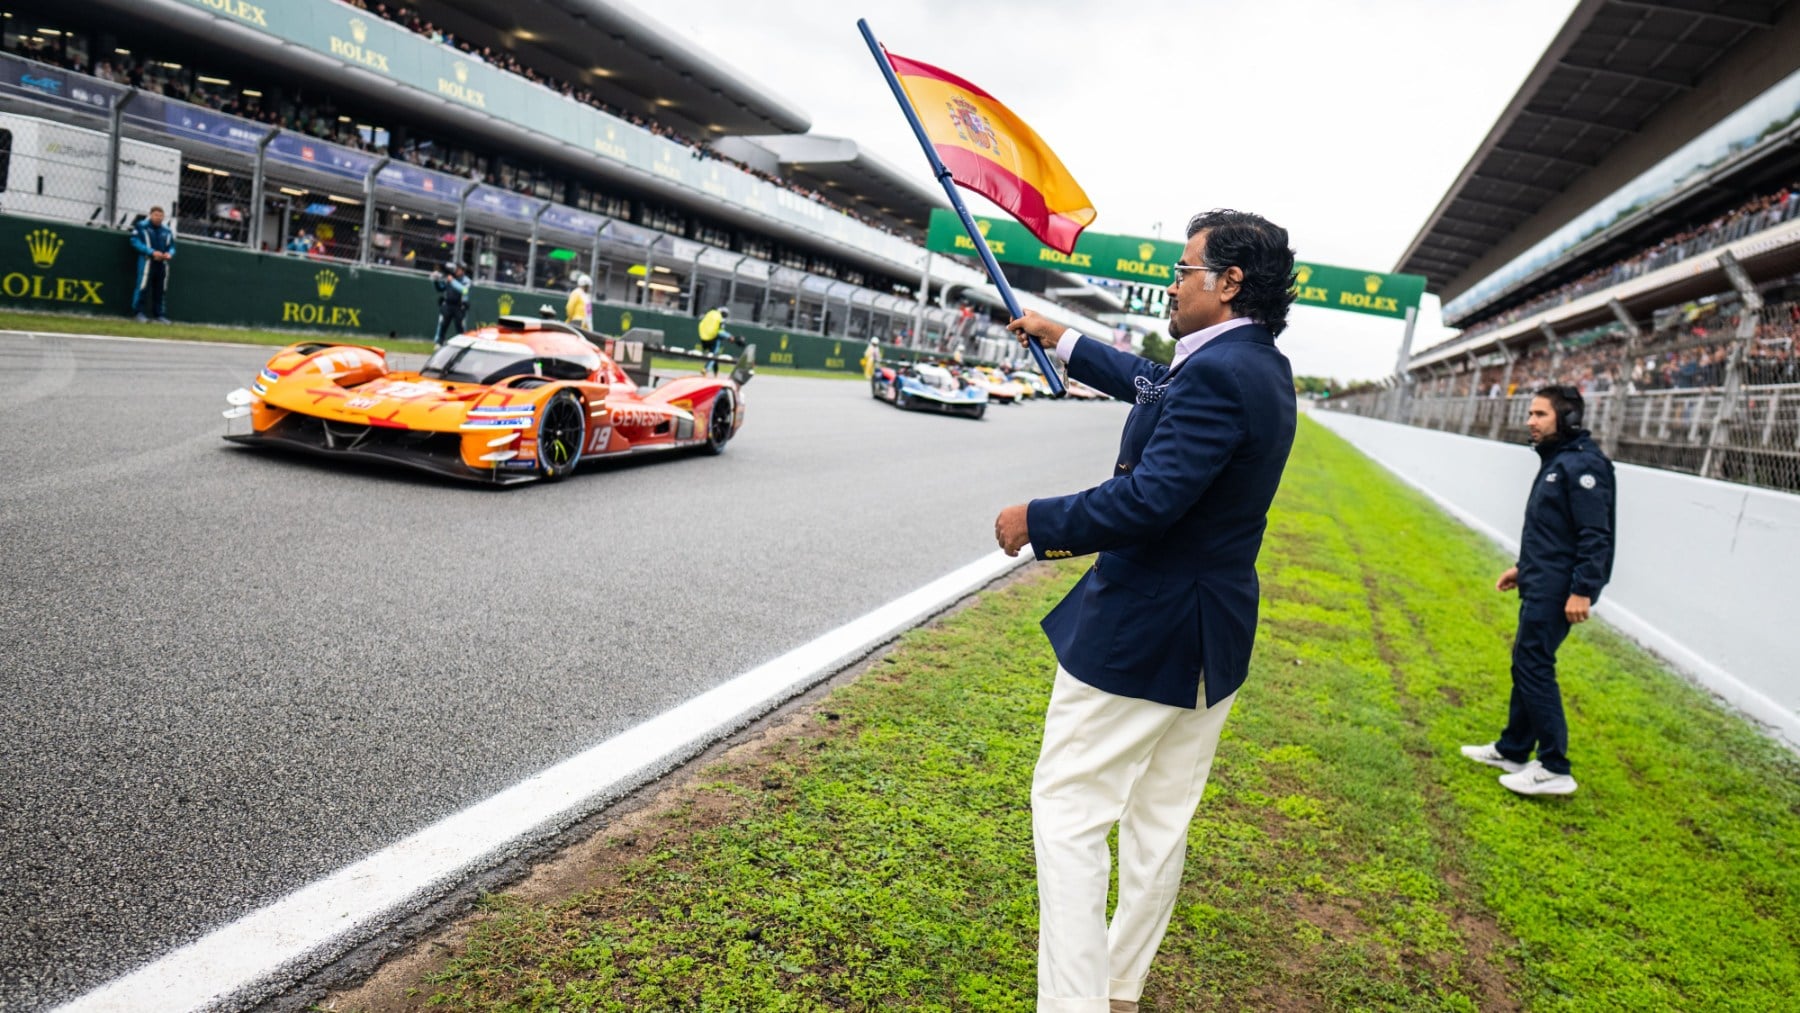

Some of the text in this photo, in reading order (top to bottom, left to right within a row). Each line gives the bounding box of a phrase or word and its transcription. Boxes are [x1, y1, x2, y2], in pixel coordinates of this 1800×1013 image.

[194, 0, 268, 27] OLEX
[330, 36, 390, 73] ROLEX
[437, 77, 486, 108] ROLEX
[954, 235, 1006, 254] ROEX
[1039, 248, 1092, 268] ROLEX
[1116, 258, 1170, 278] ROLEX
[0, 272, 104, 305] OLEX
[1340, 291, 1397, 312] ROLEX
[283, 302, 361, 328] ROLEX
[610, 407, 666, 427] GENESIS
[588, 426, 612, 452] 19
